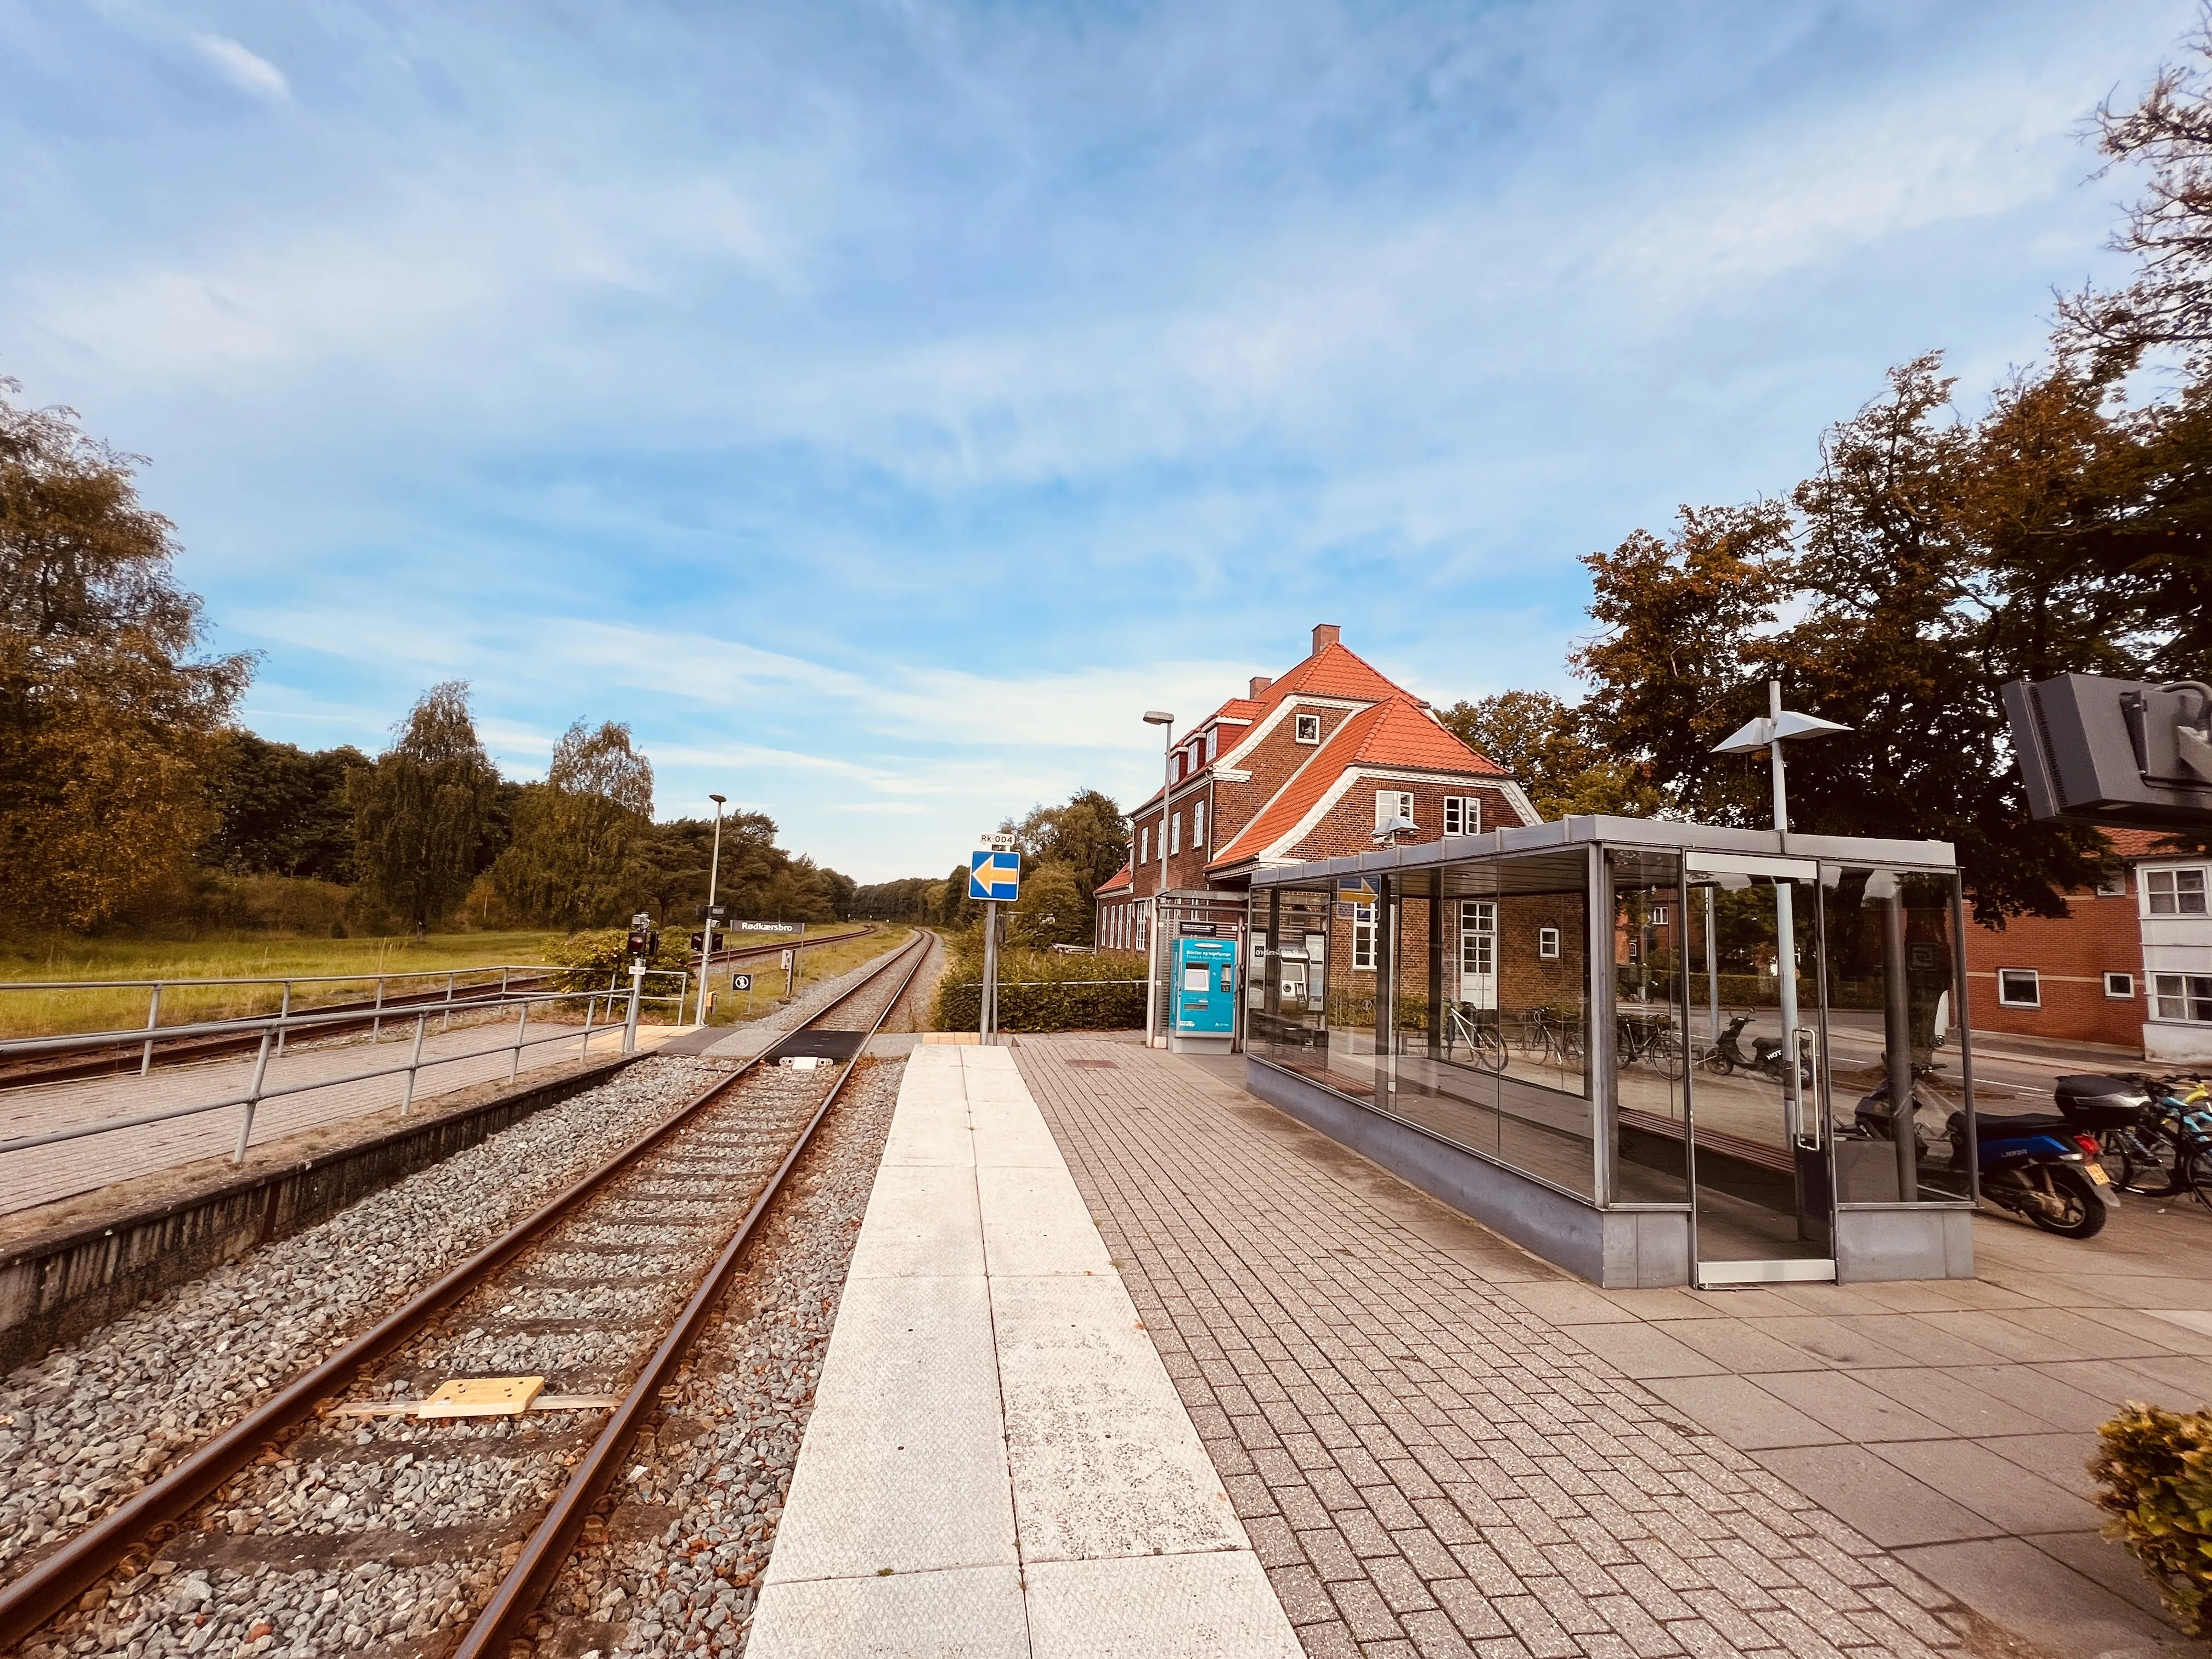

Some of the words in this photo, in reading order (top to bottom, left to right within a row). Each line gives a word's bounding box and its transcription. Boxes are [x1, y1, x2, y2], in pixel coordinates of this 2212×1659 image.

[981, 834, 1012, 843] Rk-004
[742, 922, 793, 932] Rødkærsbro
[1766, 1049, 1781, 1060] HOT
